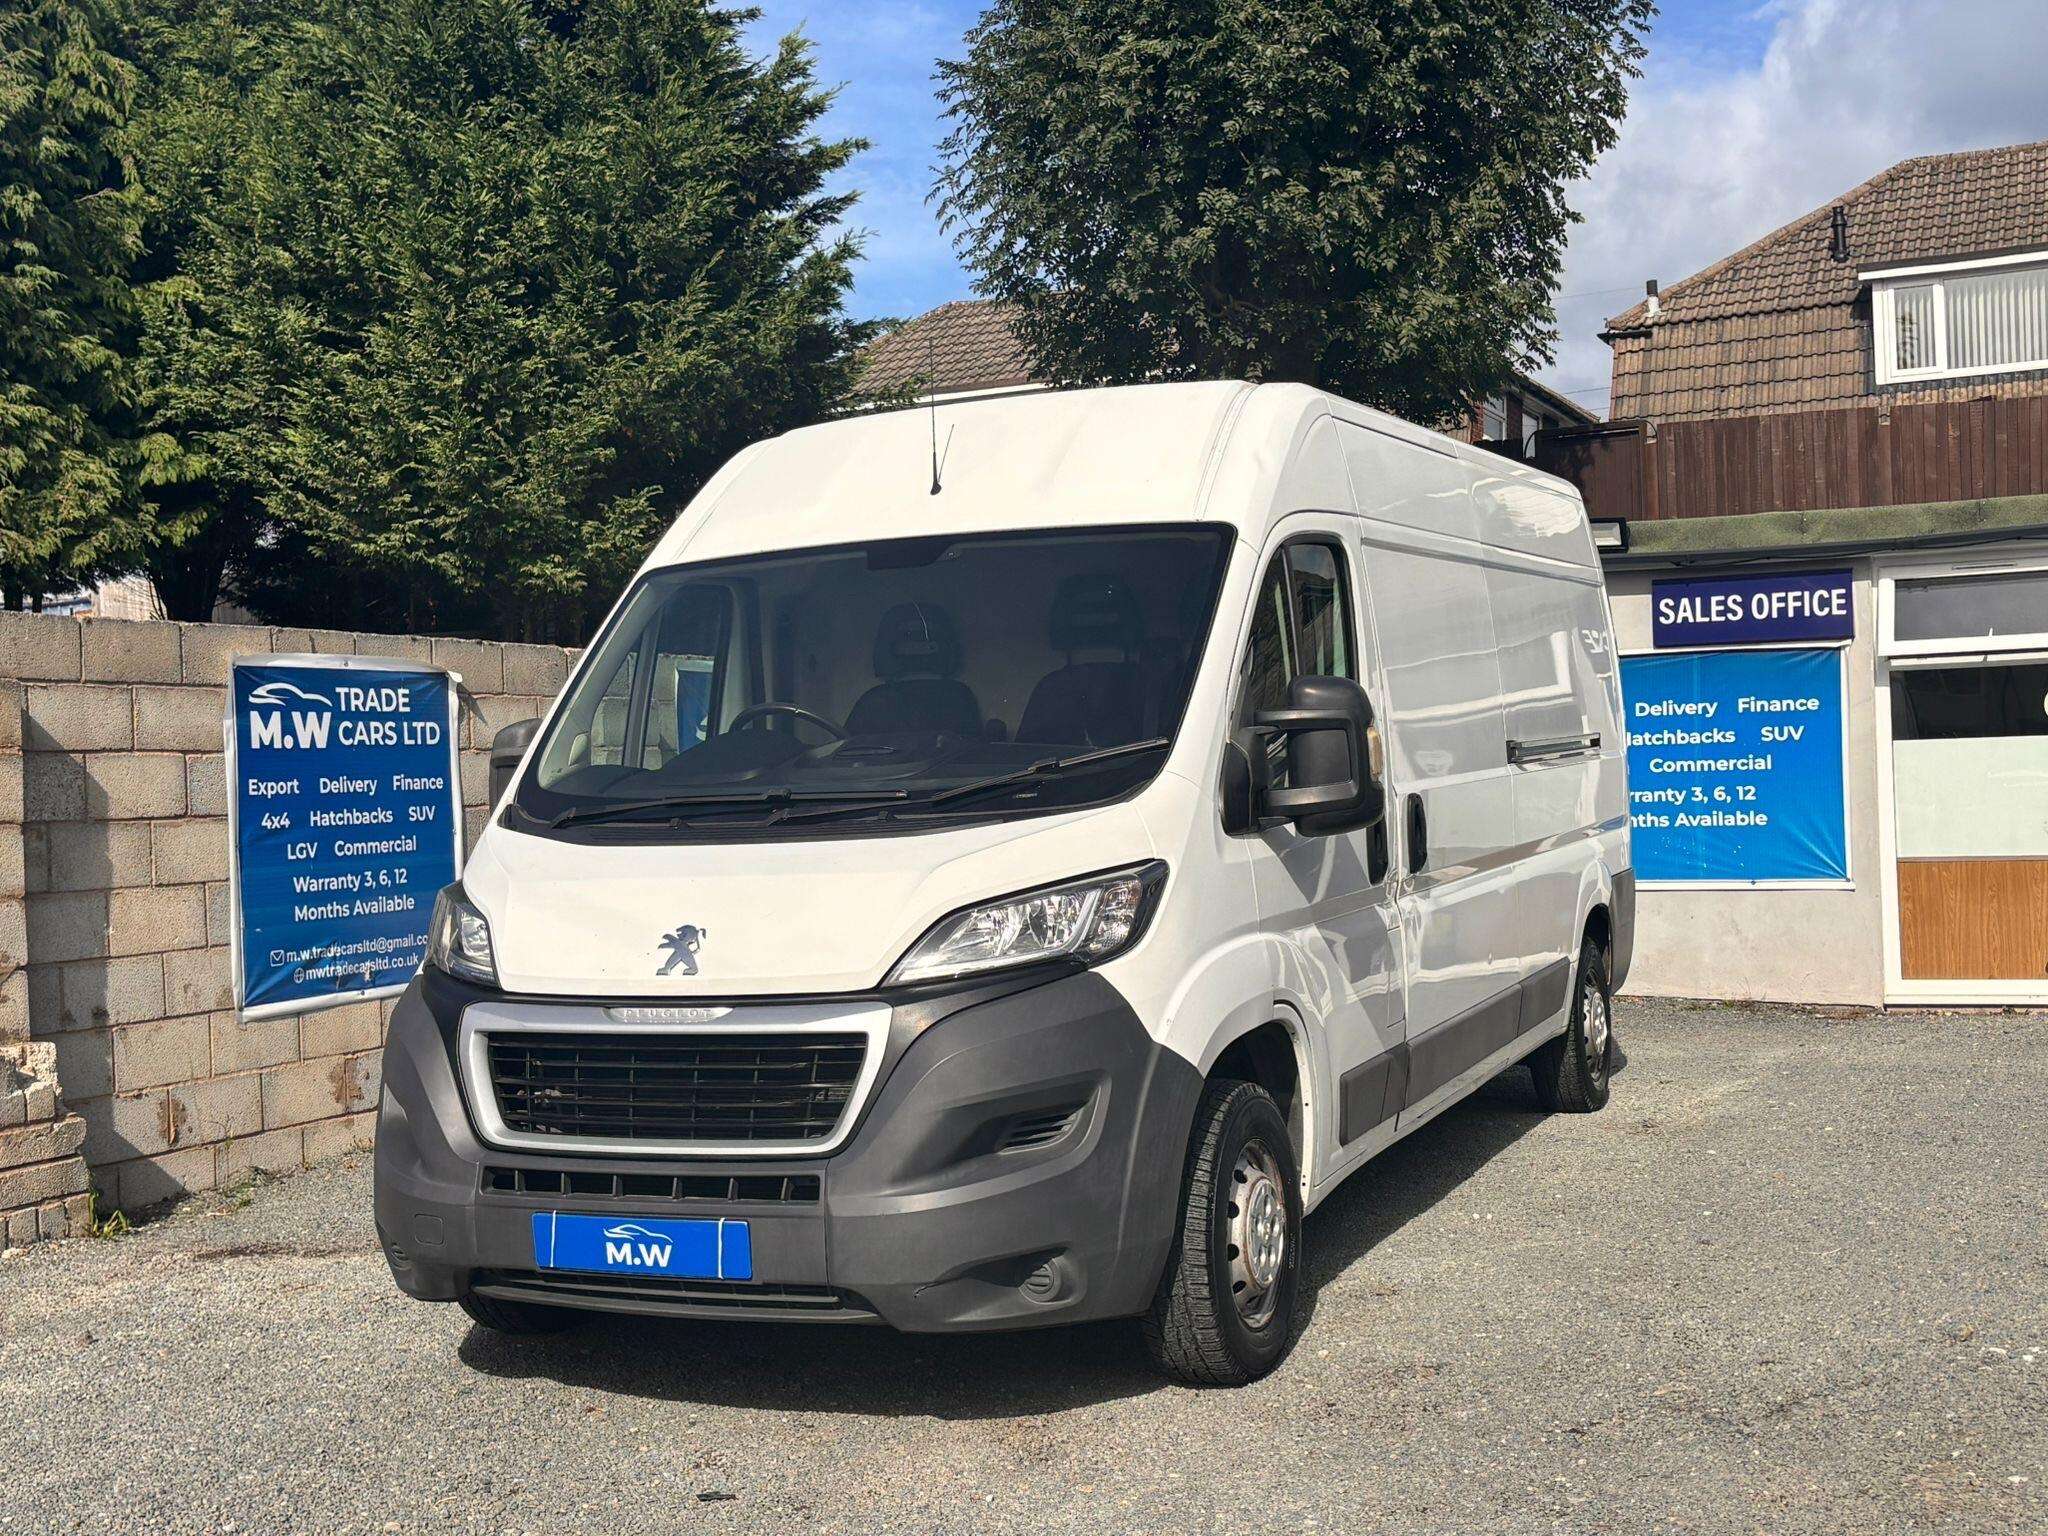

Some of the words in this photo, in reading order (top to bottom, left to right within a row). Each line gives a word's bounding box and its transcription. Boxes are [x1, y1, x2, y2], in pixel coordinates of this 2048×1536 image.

[1658, 595, 1744, 625] SALES
[1751, 588, 1847, 620] OFFICE
[335, 687, 411, 712] TRADE
[1635, 699, 1718, 717] Delivery
[1737, 697, 1820, 713] Finance
[250, 711, 332, 749] M.W
[338, 721, 398, 746] CARS
[402, 721, 440, 745] LTD
[1761, 726, 1804, 742] SUV
[1649, 754, 1772, 773] Commercial
[248, 778, 300, 798] Export
[319, 775, 377, 796] Delivery
[392, 774, 444, 791] Finance
[1630, 788, 1687, 805] rranty
[1691, 786, 1709, 804] 3,
[1713, 786, 1732, 803] 6,
[1736, 785, 1757, 801] 12
[261, 812, 291, 829] 4x4
[310, 807, 394, 827] Hatchbacks
[408, 805, 436, 822] SUV
[1630, 812, 1670, 828] nths
[1674, 810, 1769, 828] Available
[287, 842, 318, 860] LGV
[334, 835, 417, 857] Commercial
[293, 873, 361, 893] Warranty
[363, 870, 377, 889] 3,
[379, 869, 392, 888] 6,
[394, 868, 408, 884] 12
[294, 902, 350, 922] Months
[353, 894, 415, 916] Available
[286, 933, 428, 963] m.w.tradecarsltd@gmail.co
[605, 1241, 673, 1268] M.W
